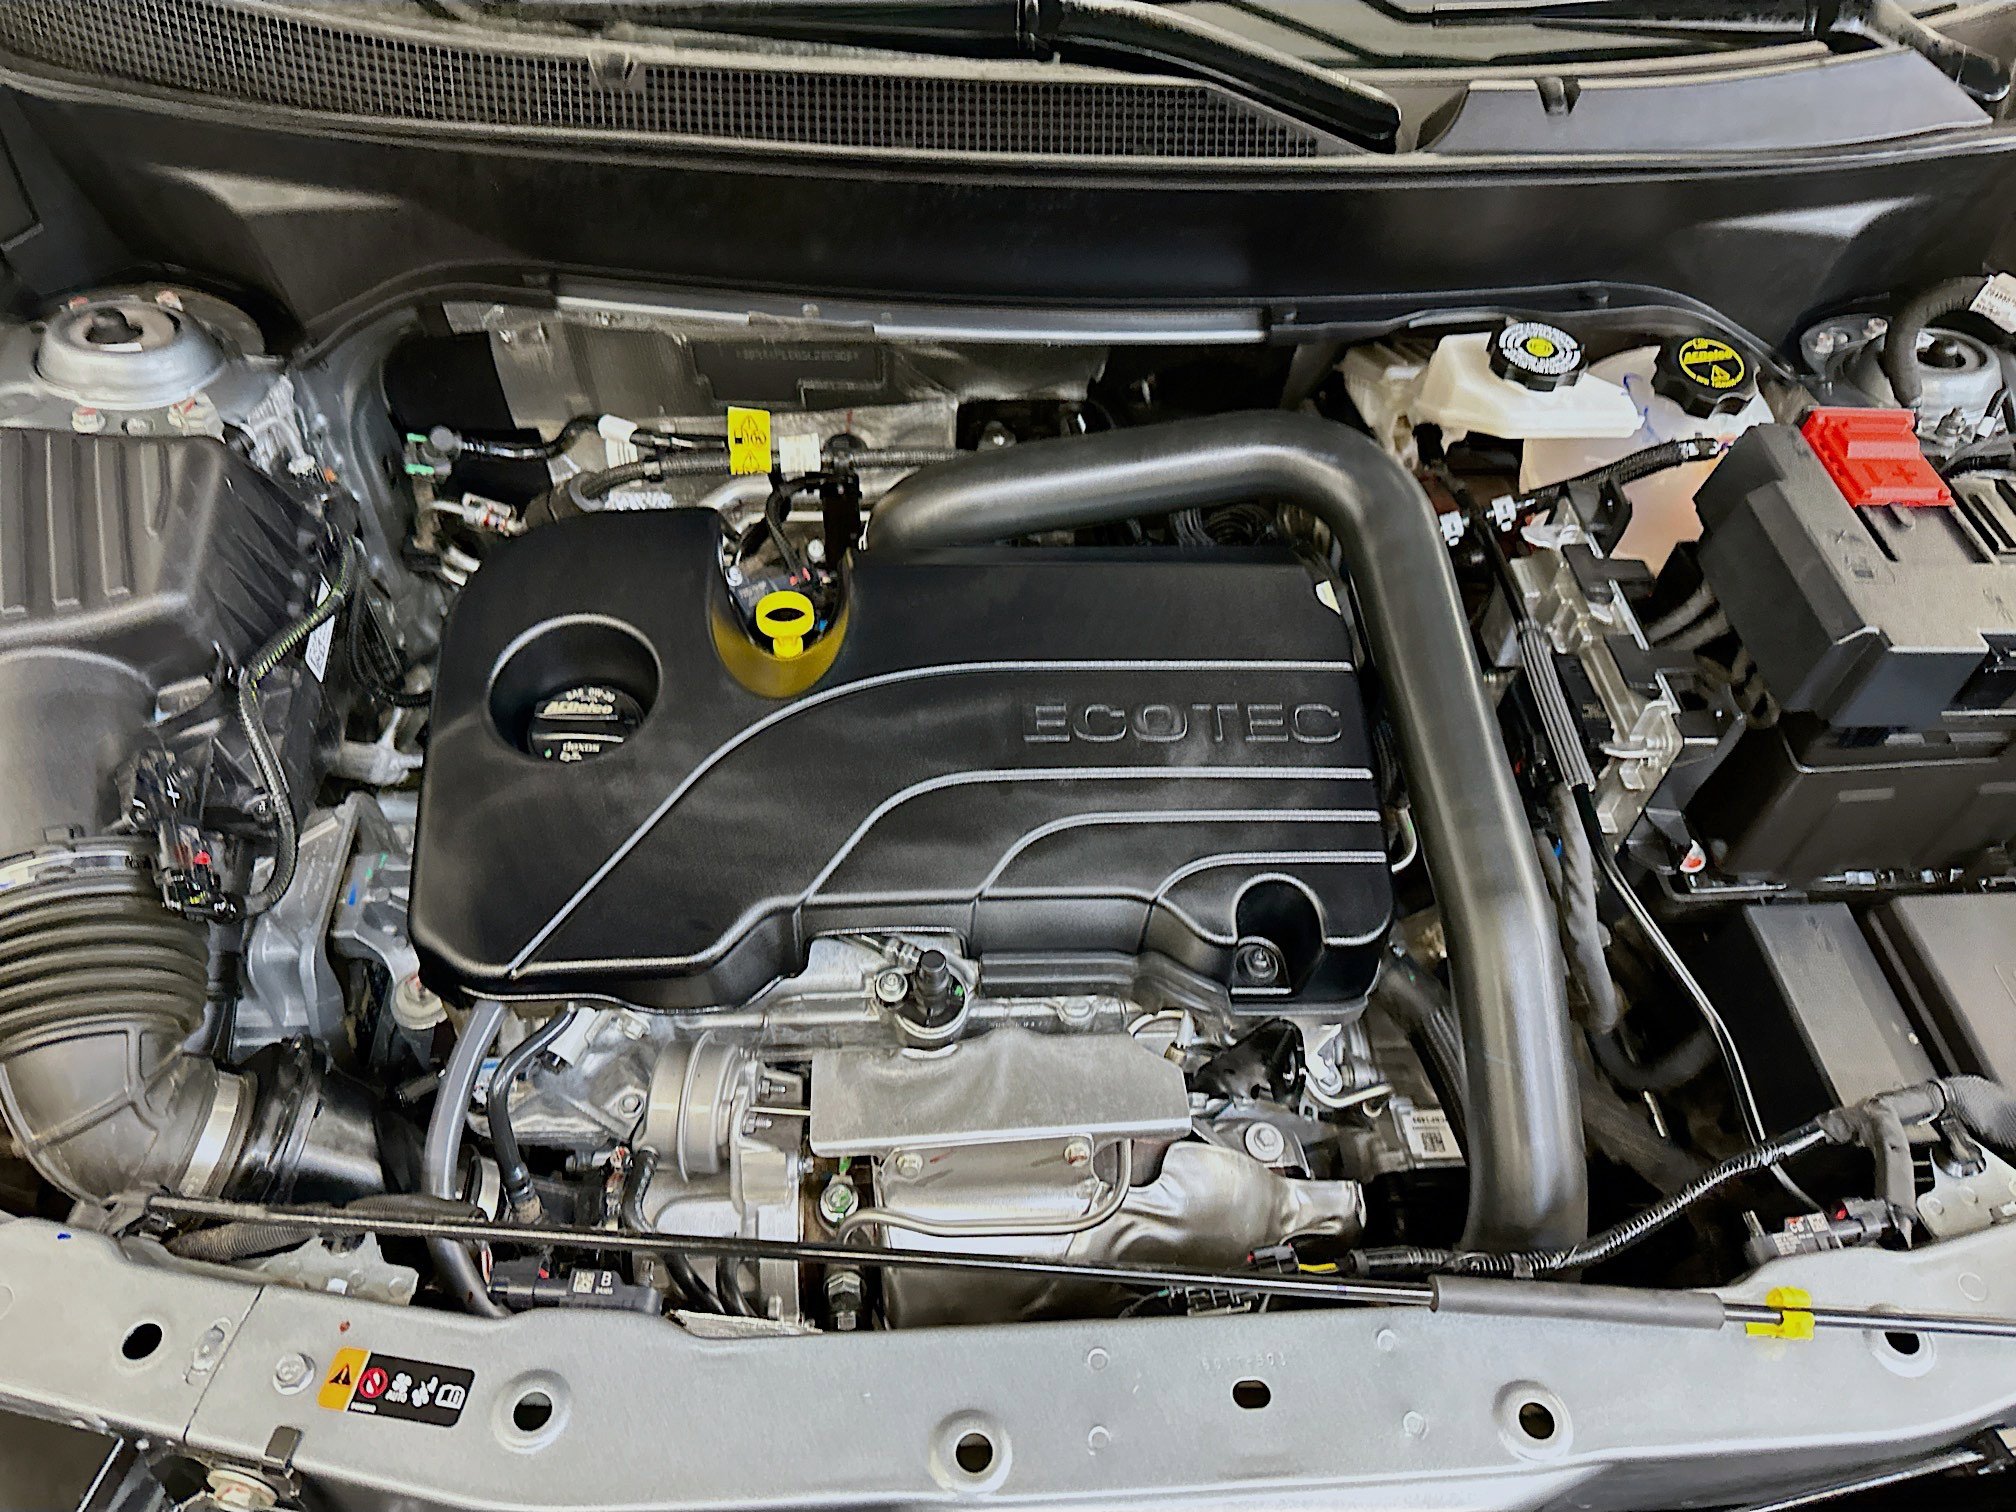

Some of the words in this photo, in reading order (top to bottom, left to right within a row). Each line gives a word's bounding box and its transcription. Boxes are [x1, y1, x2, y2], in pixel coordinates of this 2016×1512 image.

[543, 700, 614, 716] ACDelco
[1023, 702, 1343, 743] ECOTEC
[600, 1270, 613, 1287] B
[384, 1389, 408, 1404] AUTO
